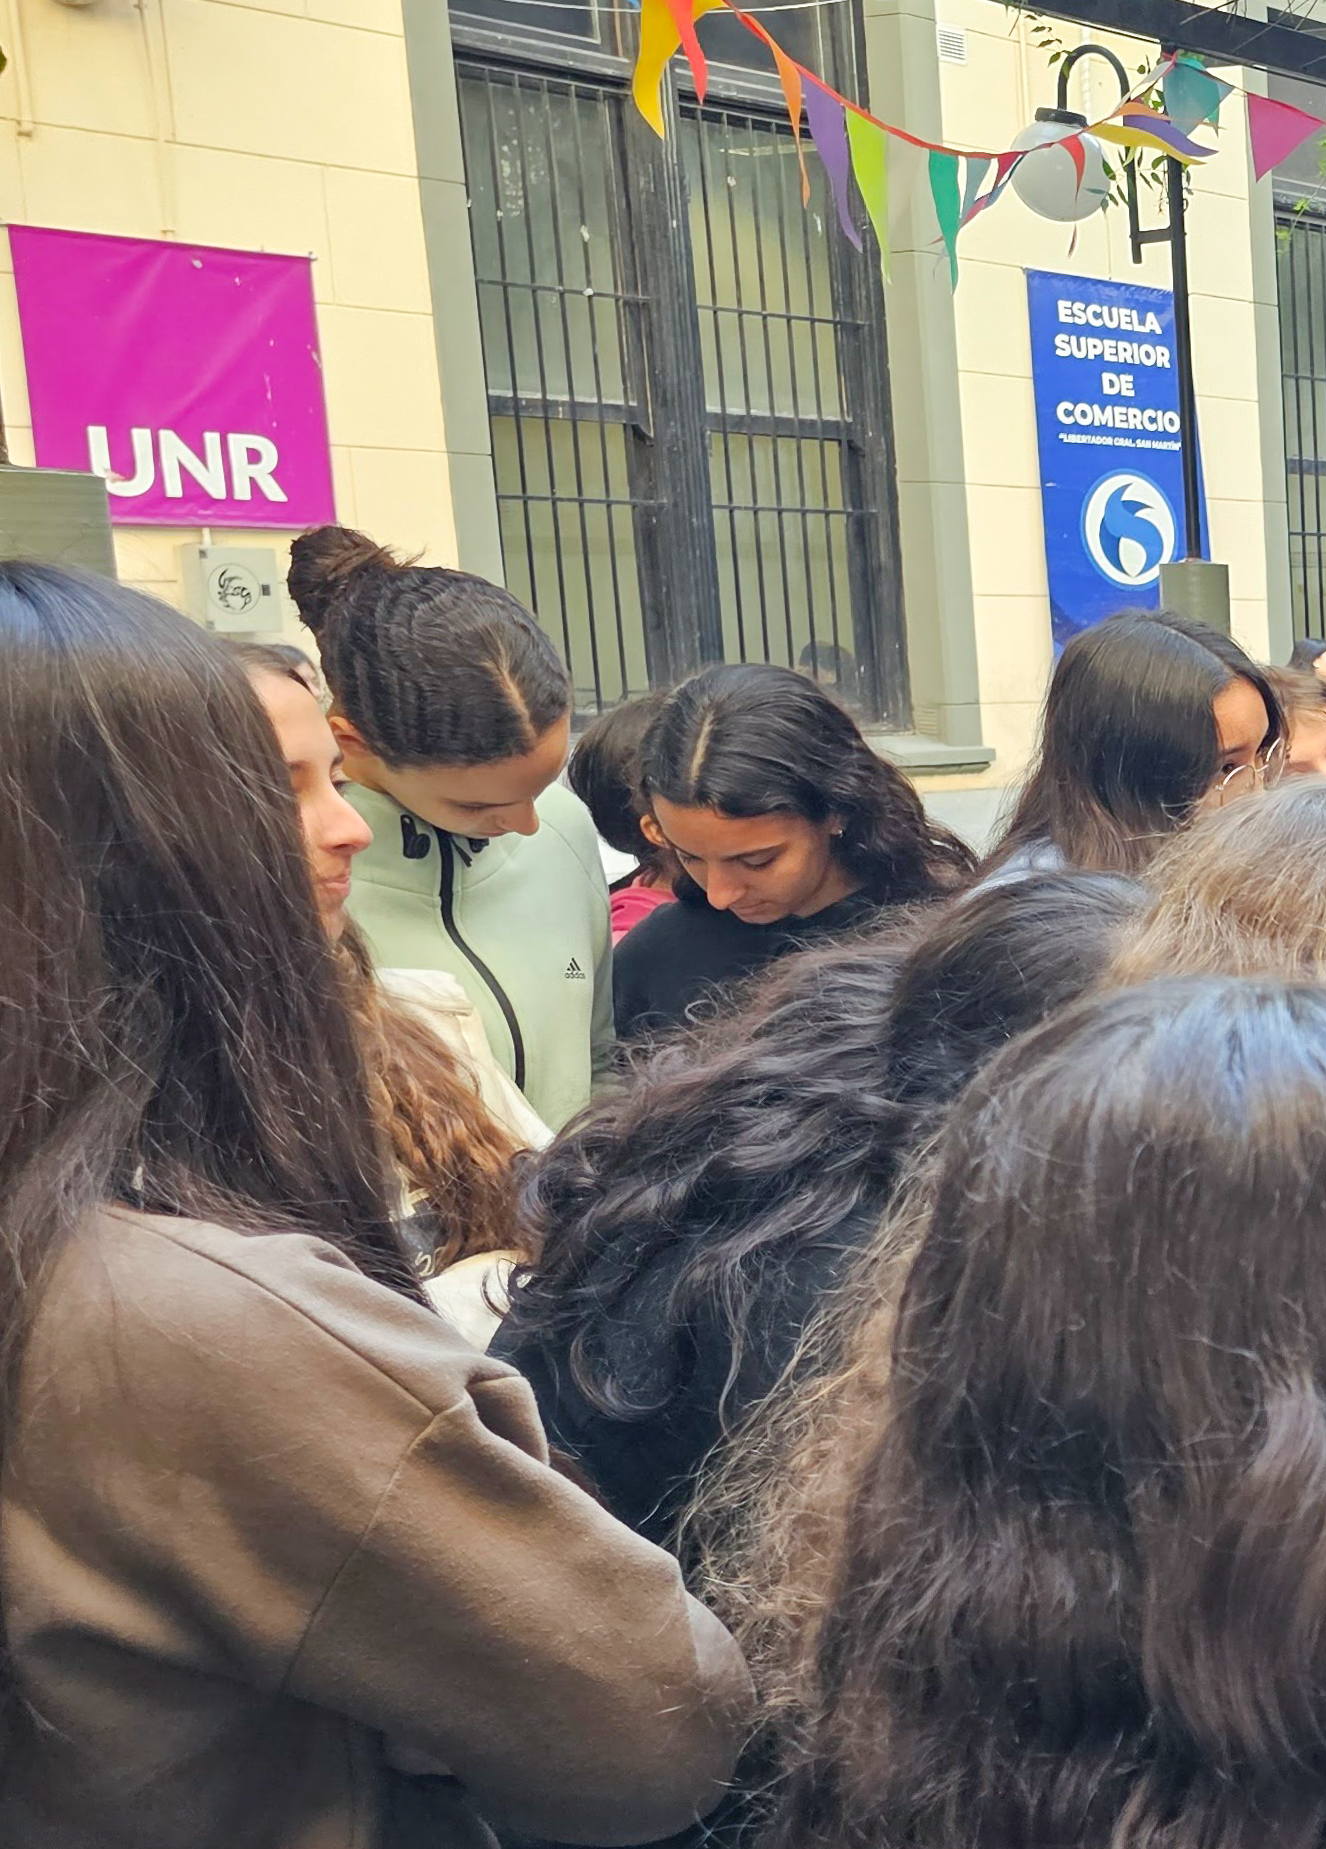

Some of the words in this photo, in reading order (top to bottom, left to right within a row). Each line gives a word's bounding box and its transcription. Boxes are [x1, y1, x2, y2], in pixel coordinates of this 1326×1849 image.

[1057, 299, 1162, 335] ESCUELA
[1054, 333, 1171, 368] SUPERIOR
[1101, 372, 1136, 397] DE
[1056, 401, 1181, 433] COMERCIO
[1135, 438, 1151, 449] SAN
[87, 425, 289, 503] UNR
